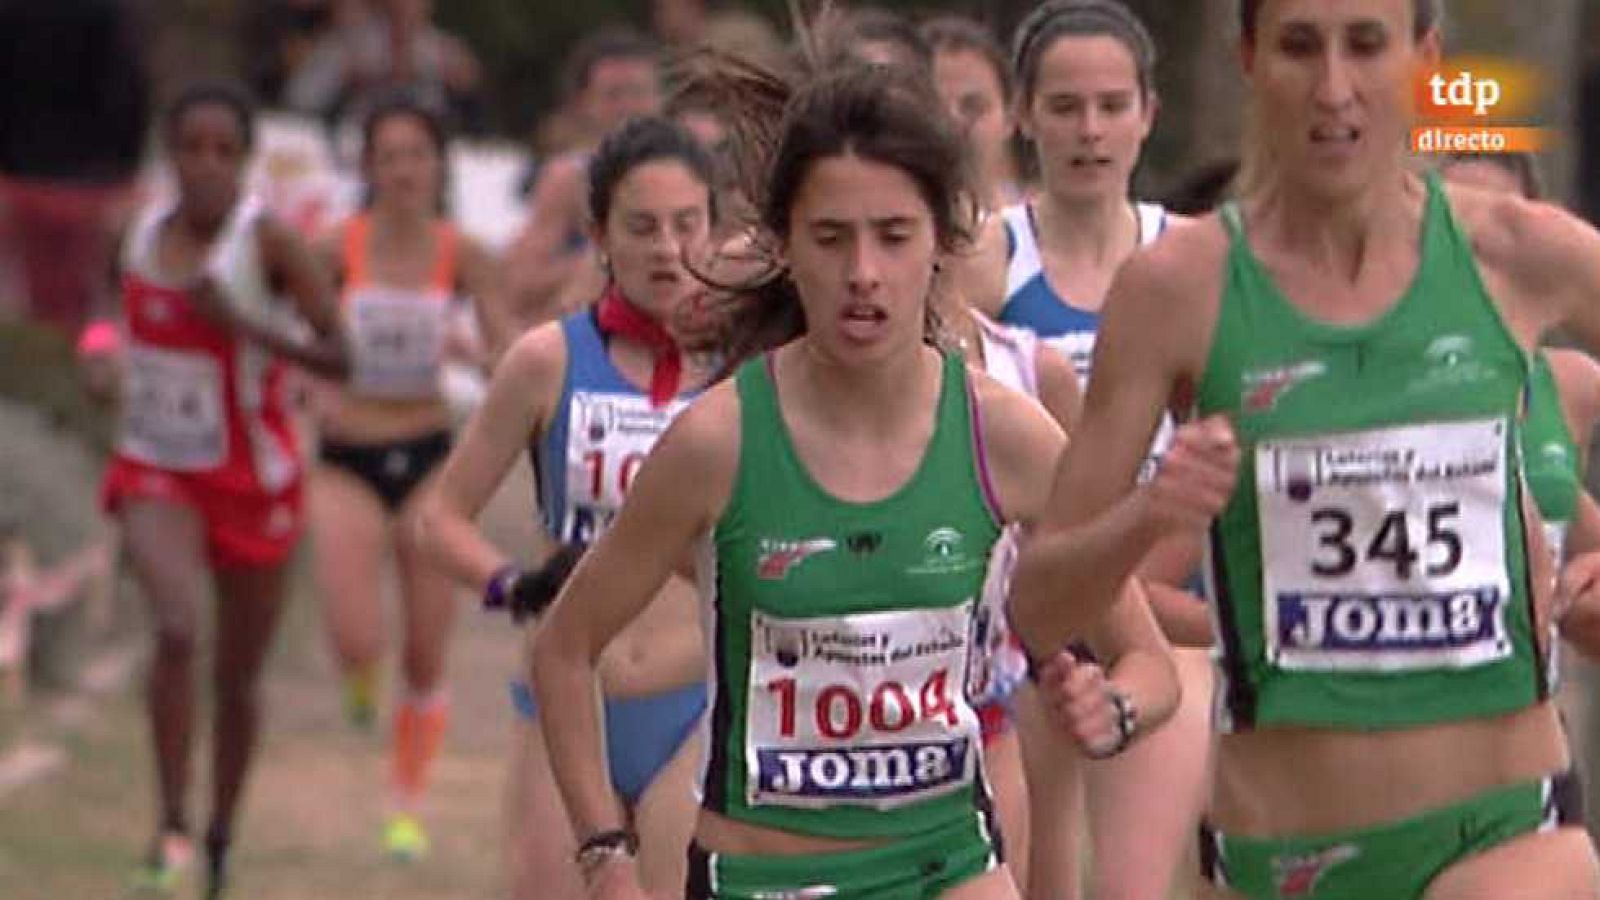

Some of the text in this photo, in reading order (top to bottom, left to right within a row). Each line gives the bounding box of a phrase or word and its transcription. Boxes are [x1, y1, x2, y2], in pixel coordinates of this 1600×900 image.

[1309, 501, 1463, 580] 345
[766, 667, 959, 738] 1004
[771, 746, 948, 787] Joma
